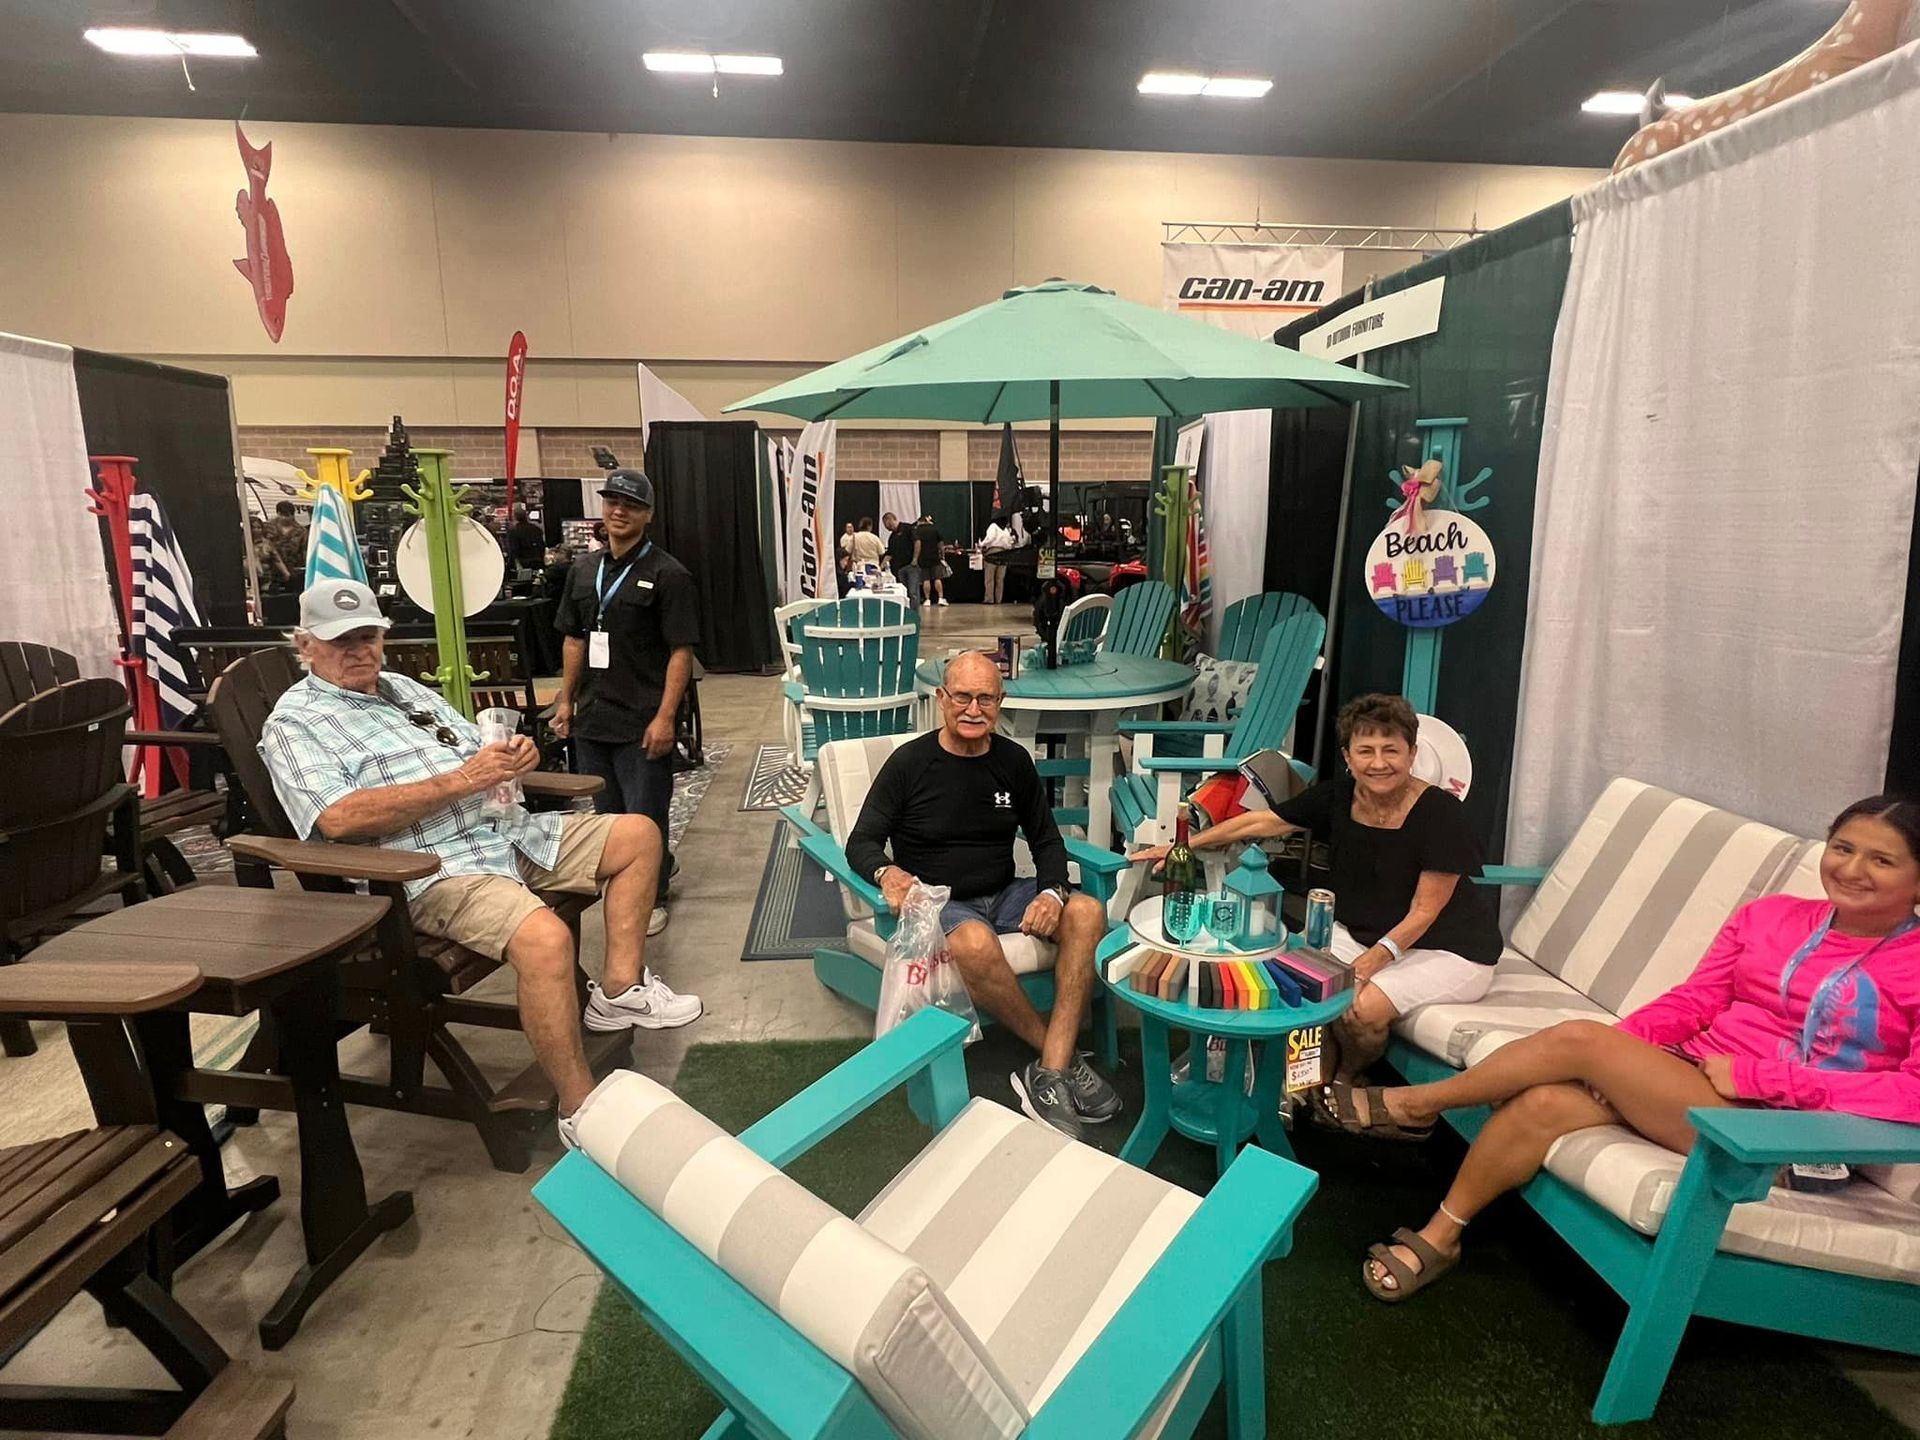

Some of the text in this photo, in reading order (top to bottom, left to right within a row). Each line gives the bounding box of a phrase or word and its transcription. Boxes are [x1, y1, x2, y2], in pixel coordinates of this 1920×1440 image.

[1179, 277, 1325, 302] can-am
[800, 454, 817, 599] can-am
[1385, 521, 1469, 558] Beach
[1394, 594, 1464, 621] PLEASE
[1287, 1025, 1323, 1061] SALE
